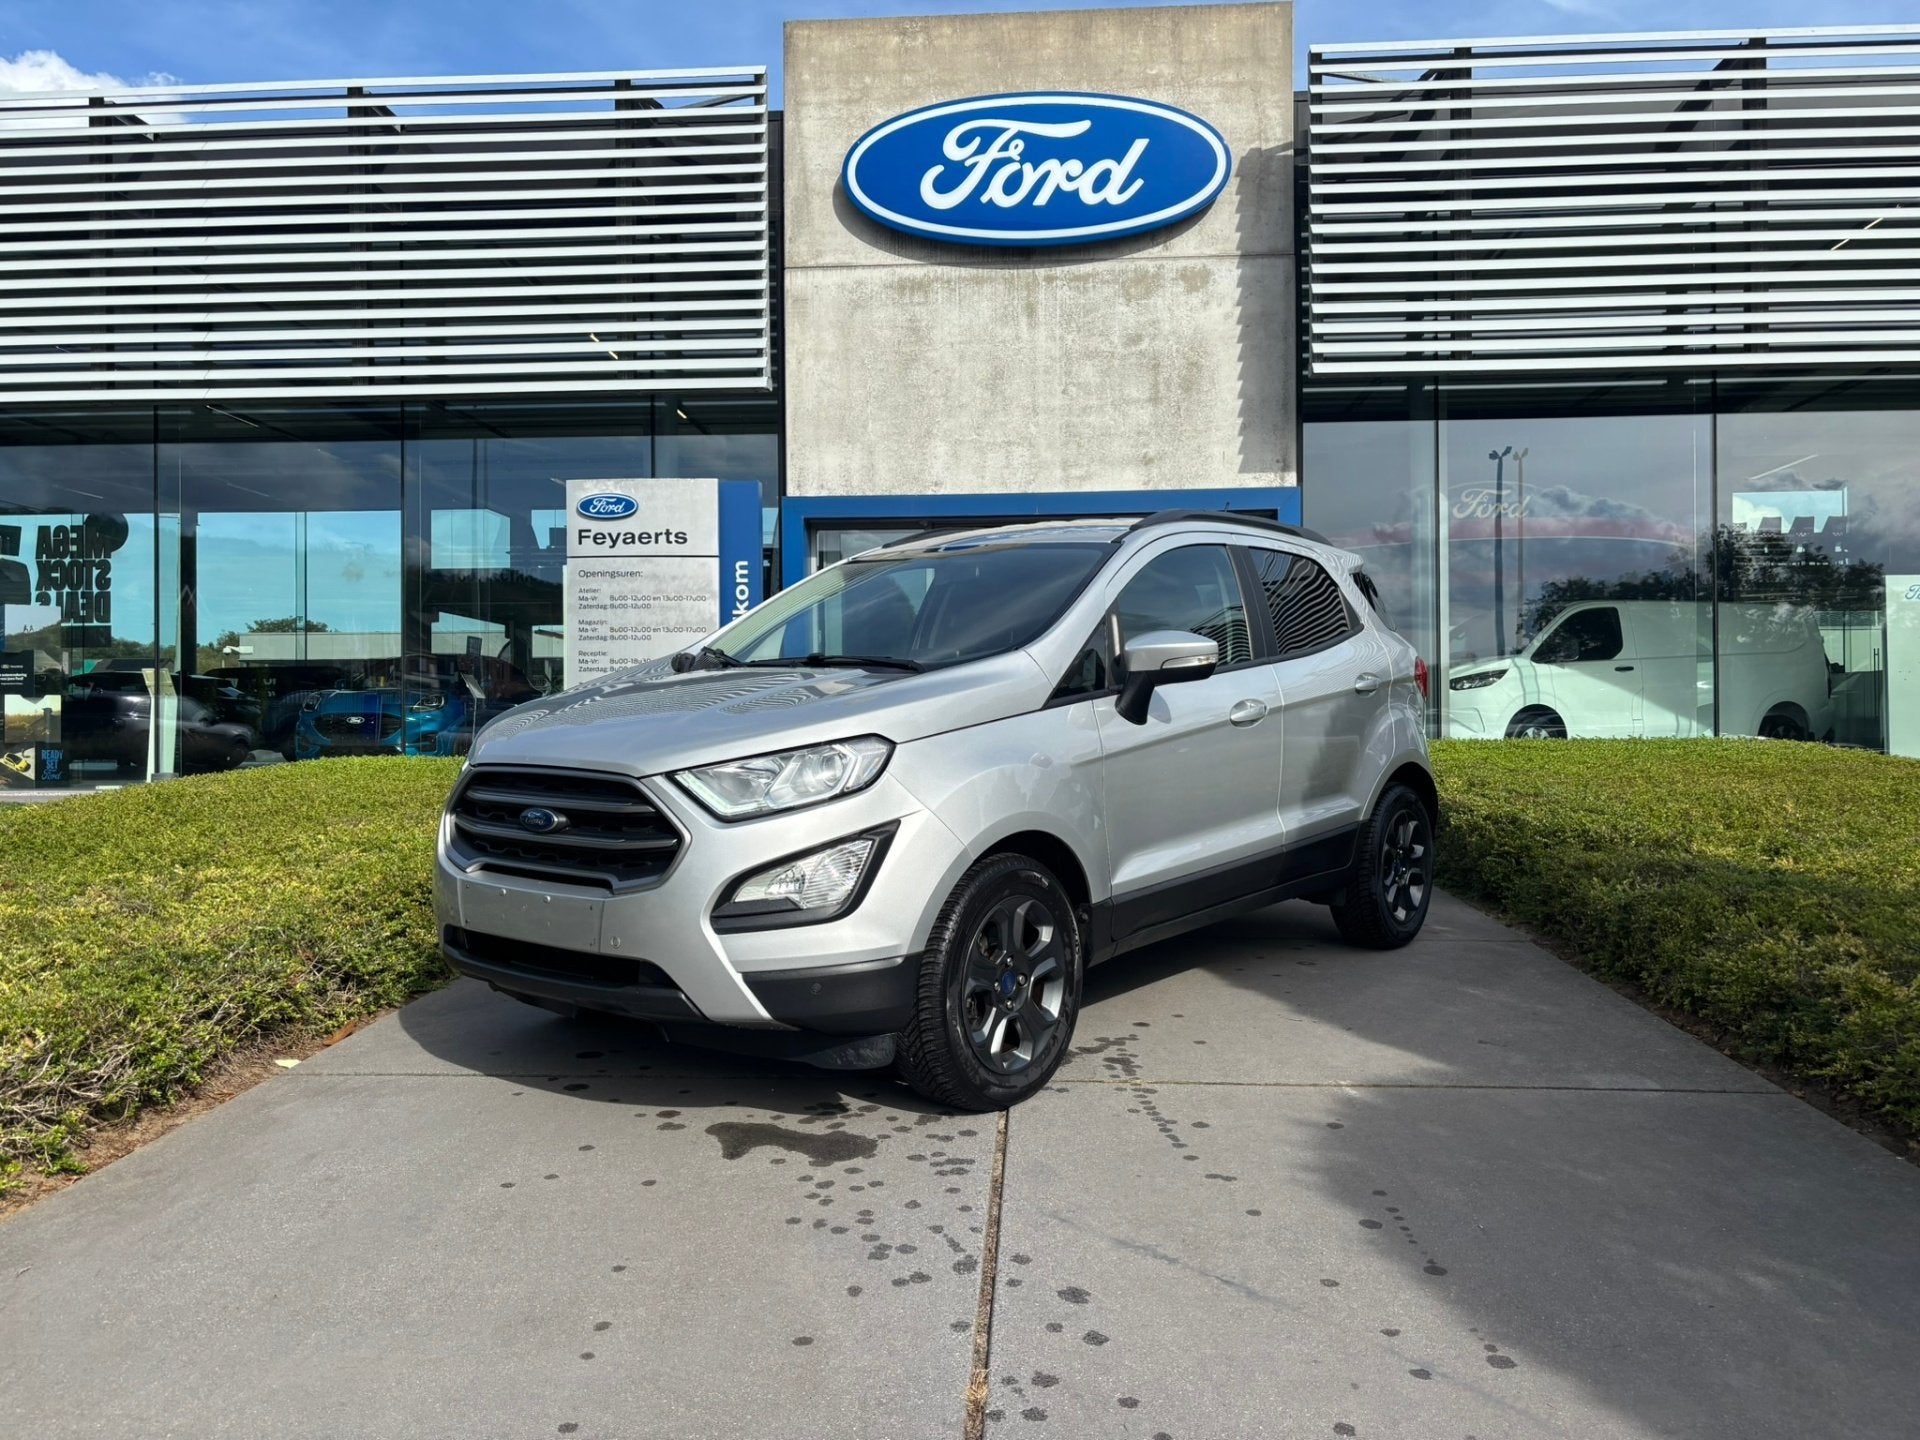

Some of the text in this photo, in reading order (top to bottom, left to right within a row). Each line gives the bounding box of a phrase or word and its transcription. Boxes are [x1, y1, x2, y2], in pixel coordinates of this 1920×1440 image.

[919, 119, 1150, 210] Ford
[588, 496, 625, 514] Ford
[1453, 488, 1531, 519] Ford
[578, 528, 688, 549] Feyaerts
[578, 569, 643, 579] Openingsuren:
[732, 560, 749, 620] kom
